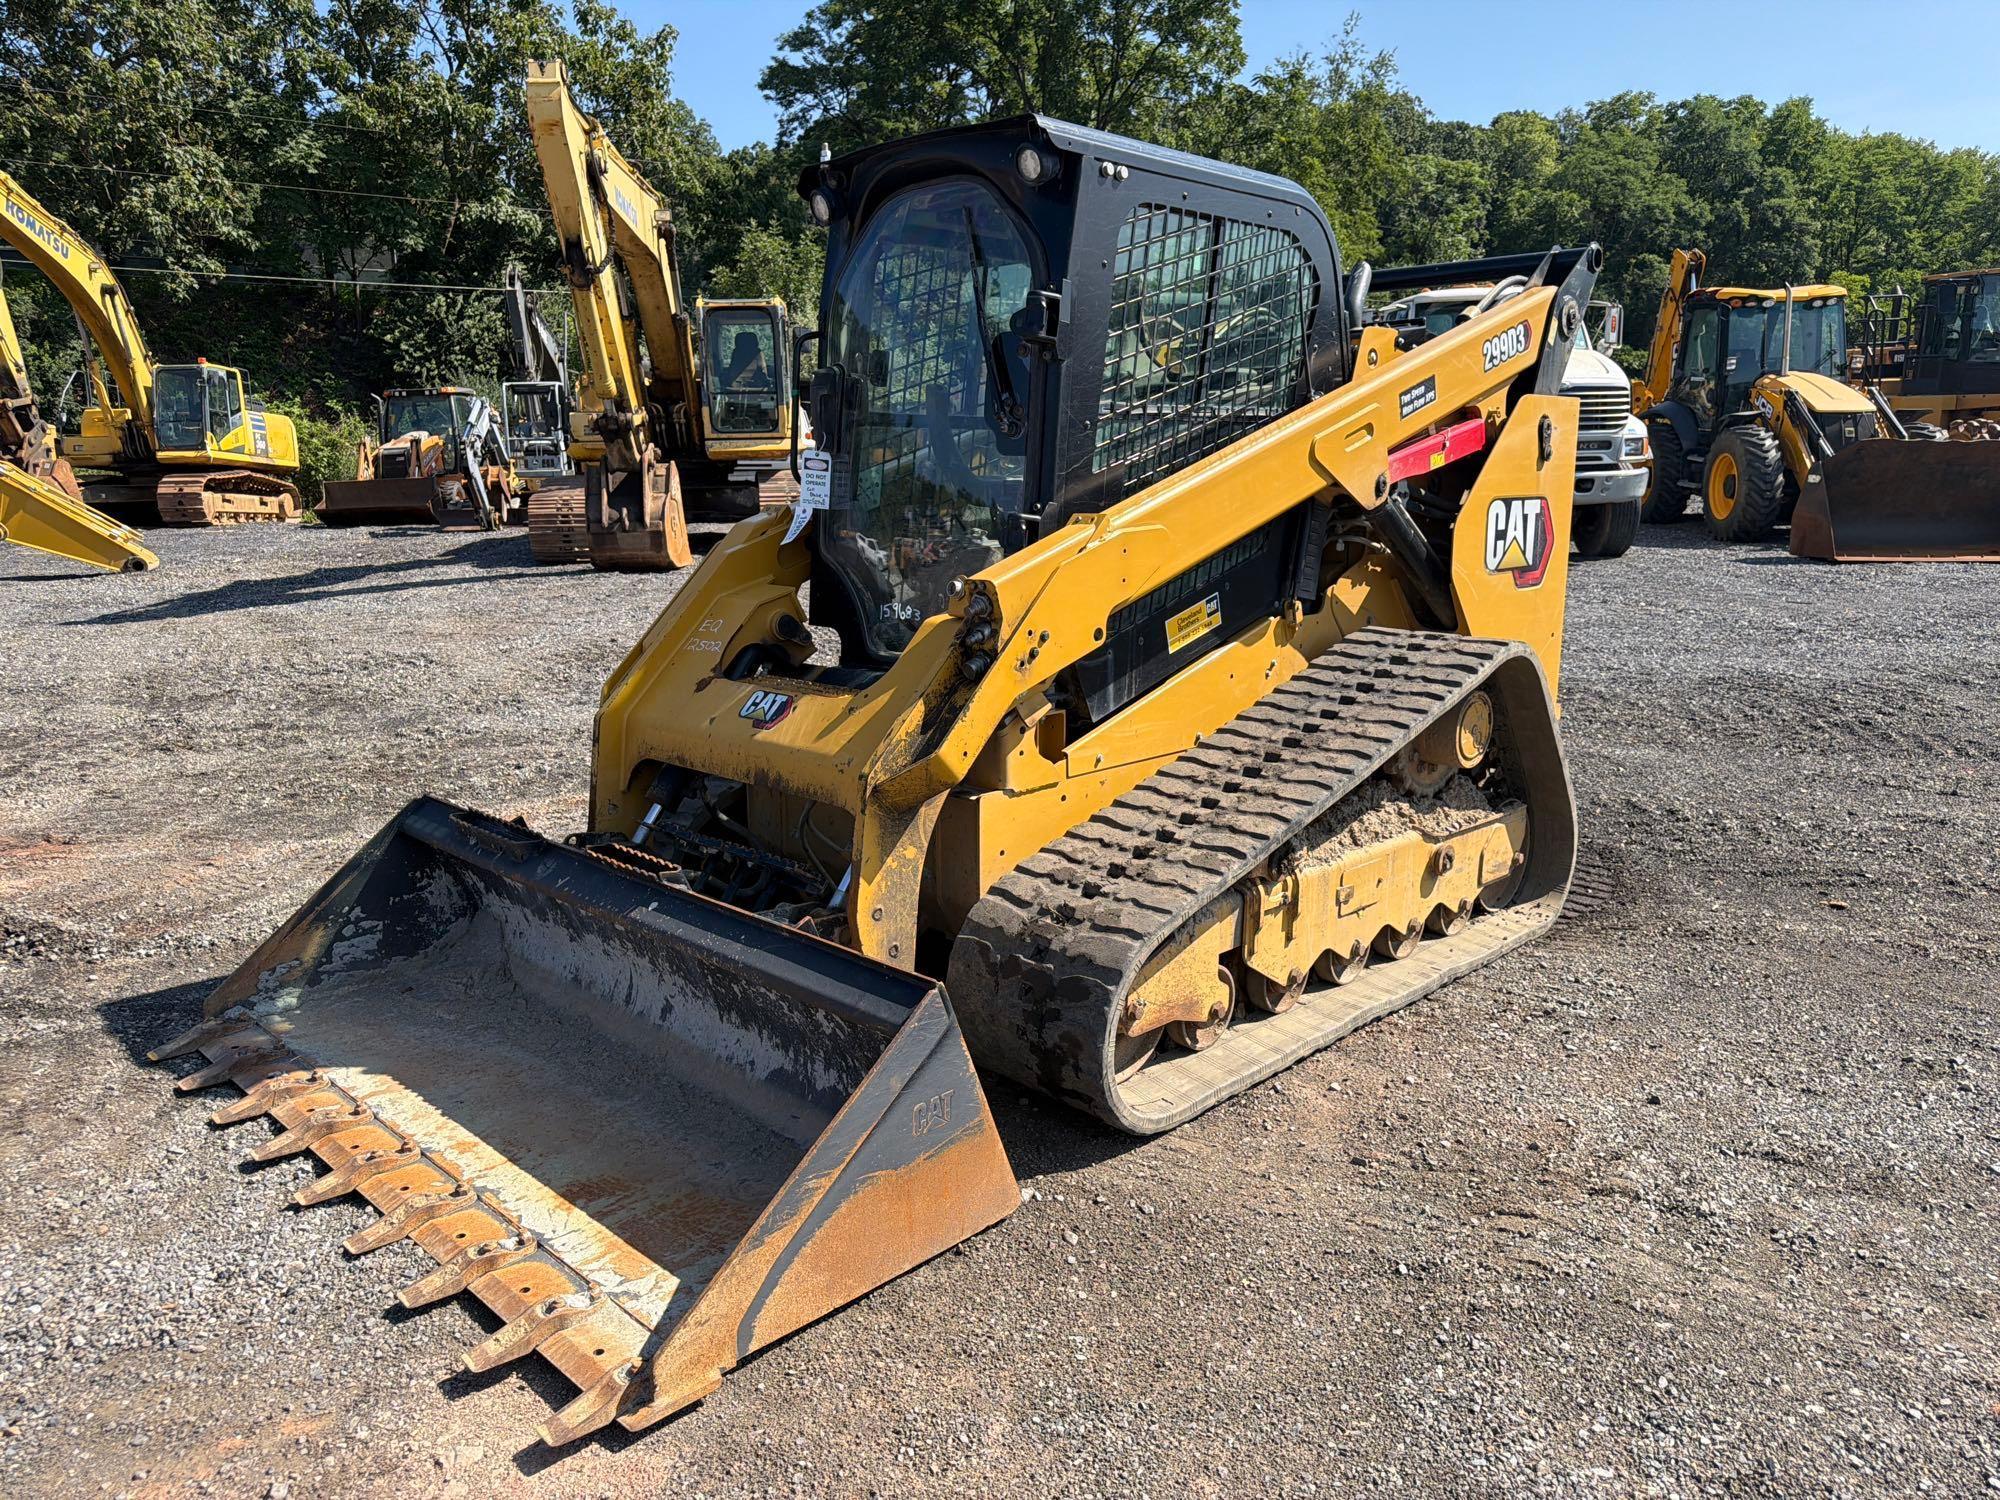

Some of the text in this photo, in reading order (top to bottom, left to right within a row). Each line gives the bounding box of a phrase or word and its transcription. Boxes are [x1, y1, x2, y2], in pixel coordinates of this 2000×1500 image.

[5, 200, 70, 259] KOMATSU
[1483, 323, 1526, 372] 299D3
[1754, 393, 1774, 419] JCB
[1486, 499, 1541, 571] CAT
[880, 602, 921, 620] 159683
[1177, 606, 1203, 626] Cleveland
[1206, 599, 1218, 614] CAT
[698, 619, 724, 633] EQ
[1177, 616, 1200, 632] Brothers
[740, 690, 789, 721] CAT
[912, 1088, 955, 1137] CAT
